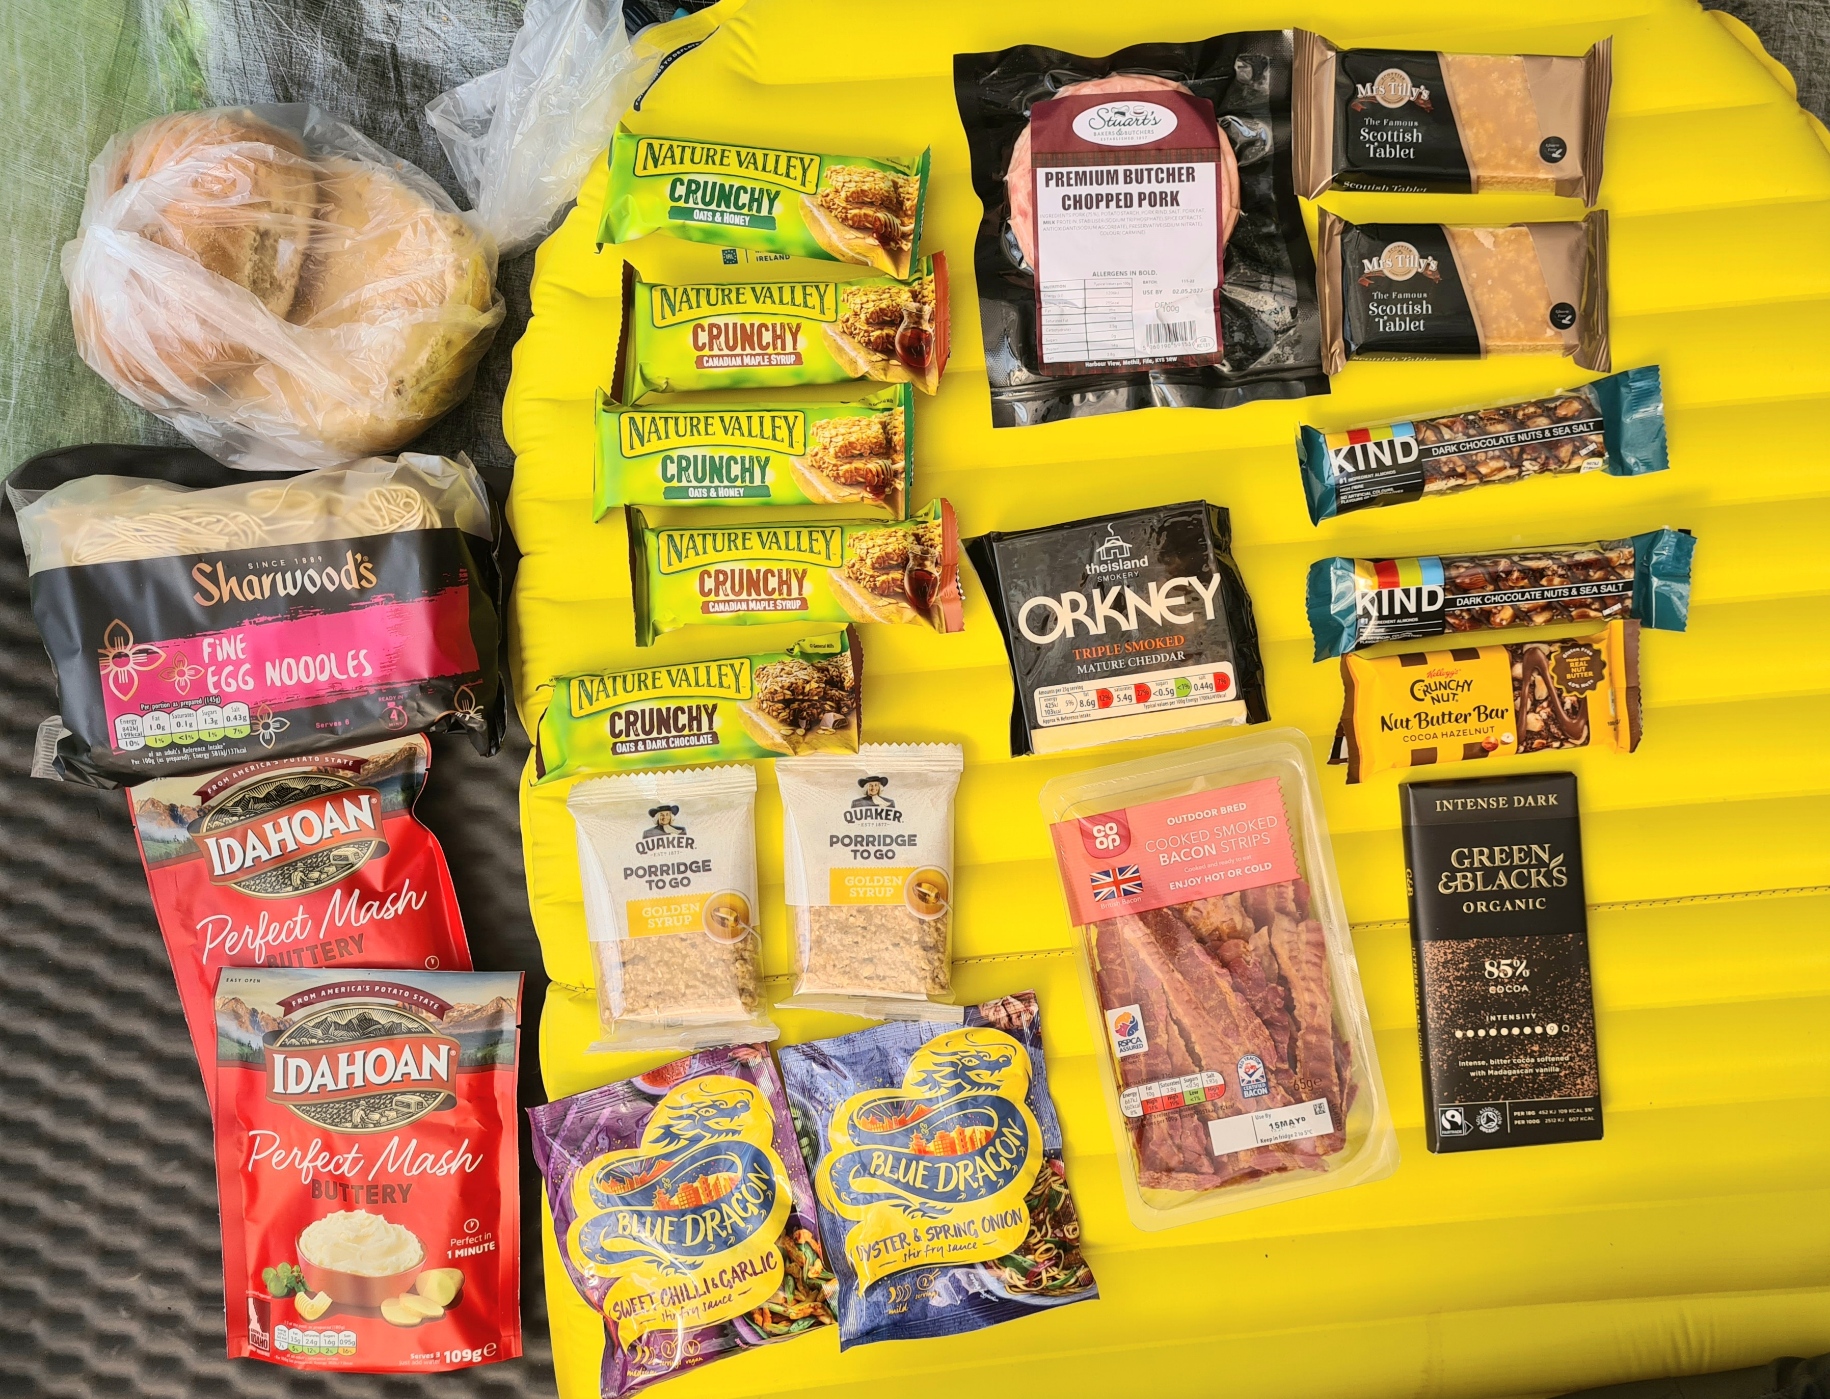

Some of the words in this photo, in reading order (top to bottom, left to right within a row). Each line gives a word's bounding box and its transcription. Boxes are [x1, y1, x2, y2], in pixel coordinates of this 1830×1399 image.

[1356, 83, 1385, 97] Mrs
[1388, 82, 1430, 101] Tilly's
[1088, 108, 1162, 130] Stuart's
[1364, 117, 1380, 126] The
[1384, 119, 1419, 127] Famous
[1360, 127, 1422, 142] Scottish
[1366, 142, 1415, 159] Tablet
[642, 142, 730, 170] NATURE
[735, 150, 815, 188] VALLEY
[1045, 168, 1119, 188] PREMIUM
[1123, 166, 1195, 185] BUTCHER
[668, 178, 781, 215] CRUNCHY
[1061, 192, 1133, 211] CHOPPED
[1138, 190, 1180, 208] PORK
[693, 211, 712, 221] OATS
[714, 212, 722, 222] &
[723, 213, 750, 226] HONEY
[1362, 257, 1392, 273] Mrs
[1395, 255, 1438, 272] Tilly's
[660, 286, 746, 321] NATURE
[751, 283, 830, 316] VALLEY
[1372, 291, 1389, 299] The
[1392, 291, 1427, 299] Famous
[1368, 300, 1432, 316] Scottish
[1375, 316, 1425, 332] Tablet
[692, 322, 802, 351] CRUNCHY
[703, 355, 741, 367] CANADIAN
[743, 355, 769, 365] MAPLE
[771, 354, 796, 365] SYRUP
[628, 416, 715, 450] NATURE
[719, 415, 799, 448] VALLEY
[1432, 444, 1457, 456] DARK
[1458, 434, 1516, 451] CHOCOLATE
[1517, 430, 1543, 443] NUTS
[1544, 429, 1551, 438] &
[1553, 425, 1573, 437] SEA
[1574, 422, 1595, 434] SALT
[1329, 436, 1419, 477] KIND
[661, 455, 770, 484] CRUNCHY
[667, 531, 751, 566] NATURE
[758, 530, 836, 561] VALLEY
[248, 558, 287, 569] SINCE
[294, 555, 323, 565] 1889
[1086, 556, 1149, 575] theisland
[192, 549, 378, 607] Sharwood's
[699, 568, 808, 597] CRUNCHY
[1097, 571, 1139, 582] SMOKERY
[1355, 585, 1444, 616] KIND
[1456, 595, 1482, 607] DARK
[1484, 589, 1543, 604] CHOCOLATE
[1545, 587, 1569, 598] NUTS
[1571, 587, 1578, 596] &
[1580, 585, 1598, 595] SEA
[1600, 582, 1624, 594] SALT
[709, 601, 747, 613] CANADIAN
[749, 600, 775, 611] MAPLE
[777, 599, 801, 610] SYRUP
[1018, 573, 1221, 644] ORKNEY
[201, 633, 248, 664] FiNE
[1073, 643, 1121, 661] TRIPLE
[1124, 635, 1185, 653] SMOKED
[206, 663, 255, 695] EGG
[265, 648, 374, 689] NOODLES
[1076, 657, 1126, 674] MATURE
[1128, 650, 1185, 667] CHEDDAR
[1427, 669, 1460, 679] Kellogg's
[577, 671, 663, 711] NATURE
[666, 661, 744, 692] VALLEY
[1193, 682, 1213, 692] 0.44g
[1410, 679, 1473, 701] CRUNCHY
[1079, 699, 1096, 708] 8.6g
[1116, 693, 1133, 703] 5.4g
[1431, 692, 1456, 705] NUT
[225, 714, 248, 723] 0.43g
[609, 703, 718, 740] CRUNCHY
[1381, 713, 1413, 732] Nut
[1414, 708, 1471, 730] Butter
[1473, 705, 1509, 723] Bar
[1403, 732, 1438, 743] COCOA
[1441, 726, 1495, 738] HAZELNUT
[1435, 796, 1508, 812] INTENSE
[1513, 794, 1559, 807] DARK
[844, 808, 902, 824] QUAKER
[1167, 807, 1218, 826] OUTDOOR
[1220, 802, 1247, 816] BRED
[204, 794, 376, 877] IDAHOAN
[829, 834, 918, 848] PORRIDGE
[1145, 830, 1210, 853] COOKED
[1214, 816, 1278, 838] SMOKED
[636, 837, 694, 855] QUAKER
[851, 849, 871, 860] TO
[873, 849, 896, 860] GO
[1159, 844, 1217, 866] BACON
[1221, 832, 1271, 853] STRIPS
[1451, 844, 1551, 869] GREEN
[623, 859, 712, 881] PORRIDGE
[1169, 875, 1202, 891] ENJOY
[1204, 872, 1225, 884] HOT
[1227, 868, 1242, 878] OR
[1244, 862, 1272, 875] COLD
[646, 878, 666, 890] TO
[668, 876, 692, 889] GO
[844, 876, 903, 887] GOLDEN
[849, 886, 894, 898] SYRUP
[641, 902, 701, 918] GOLDEN
[1463, 898, 1547, 913] ORGANIC
[195, 904, 312, 965] Perfect
[319, 878, 427, 940] Mash
[647, 914, 693, 929] SYRUP
[267, 934, 365, 968] BUTTERY
[1484, 959, 1530, 979] 85%
[292, 993, 317, 1007] FROM
[320, 984, 370, 997] AMERICA'S
[374, 984, 410, 997] POTATO
[413, 994, 440, 1010] STATE
[1488, 985, 1529, 994] COCOA
[1486, 1013, 1537, 1021] INTENSITY
[1118, 1037, 1142, 1048] RSPCA
[1119, 1043, 1144, 1053] ASSURED
[273, 1044, 451, 1095] IDAHOAN
[1487, 1067, 1534, 1076] Madagascan
[1244, 1088, 1268, 1098] BACON
[248, 1129, 364, 1185] Perfect
[368, 1136, 484, 1182] Mash
[870, 1151, 932, 1188] BLUE
[935, 1117, 1025, 1193] DRAGON
[311, 1179, 413, 1204] BUTTERY
[617, 1211, 678, 1247] BLUE
[682, 1161, 771, 1248] DRAGON
[913, 1228, 922, 1242] &
[925, 1222, 979, 1242] SPRING
[981, 1207, 1023, 1234] ONION
[450, 1235, 483, 1246] Perfect
[484, 1232, 492, 1240] in
[447, 1250, 453, 1259] 1
[455, 1241, 496, 1259] MINUTE
[612, 1293, 659, 1321] SWEET
[660, 1280, 711, 1309] CHILLI
[712, 1278, 719, 1290] &
[719, 1251, 778, 1291] GARLIC
[251, 1333, 268, 1349] IDAHO
